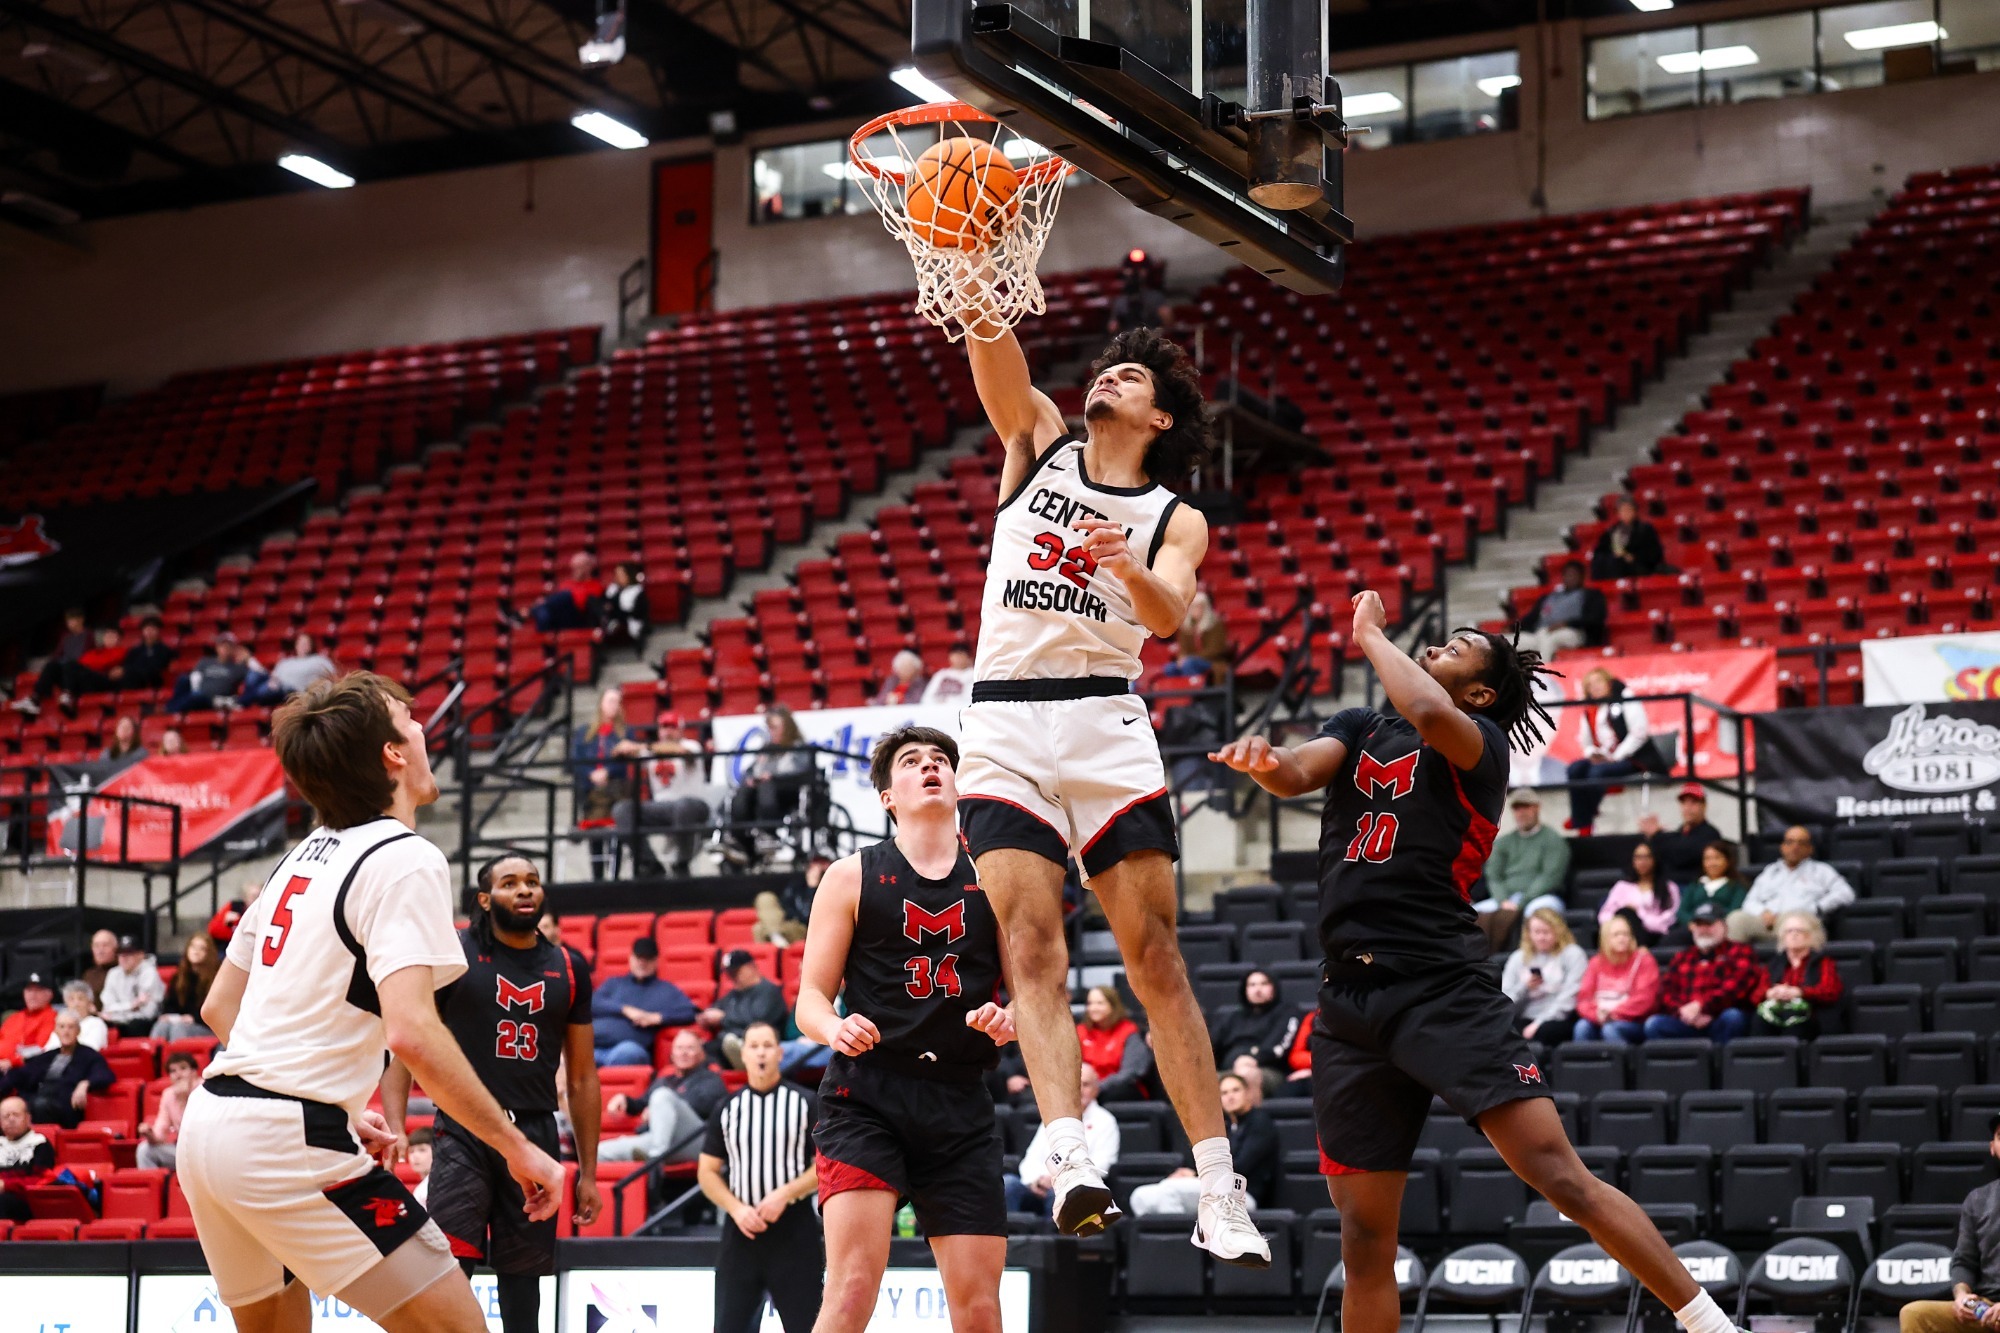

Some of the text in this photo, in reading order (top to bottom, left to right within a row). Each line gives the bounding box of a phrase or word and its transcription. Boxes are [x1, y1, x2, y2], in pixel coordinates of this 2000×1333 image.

[1028, 488, 1134, 540] CENT
[1027, 531, 1098, 590] 32
[1003, 579, 1107, 623] MISSOURI
[1354, 749, 1420, 800] M
[1912, 761, 1973, 782] 1981
[1836, 789, 1997, 818] Restaurant &
[1343, 812, 1399, 863] 10
[262, 874, 312, 967] 5
[902, 898, 965, 945] M
[496, 973, 545, 1015] M
[904, 953, 962, 999] 34
[495, 1019, 539, 1061] 23
[1444, 1259, 1515, 1285] UCM
[1549, 1259, 1620, 1284] UCM
[1679, 1255, 1729, 1282] CM
[1765, 1254, 1839, 1281] UCM
[1876, 1256, 1951, 1285] UCM
